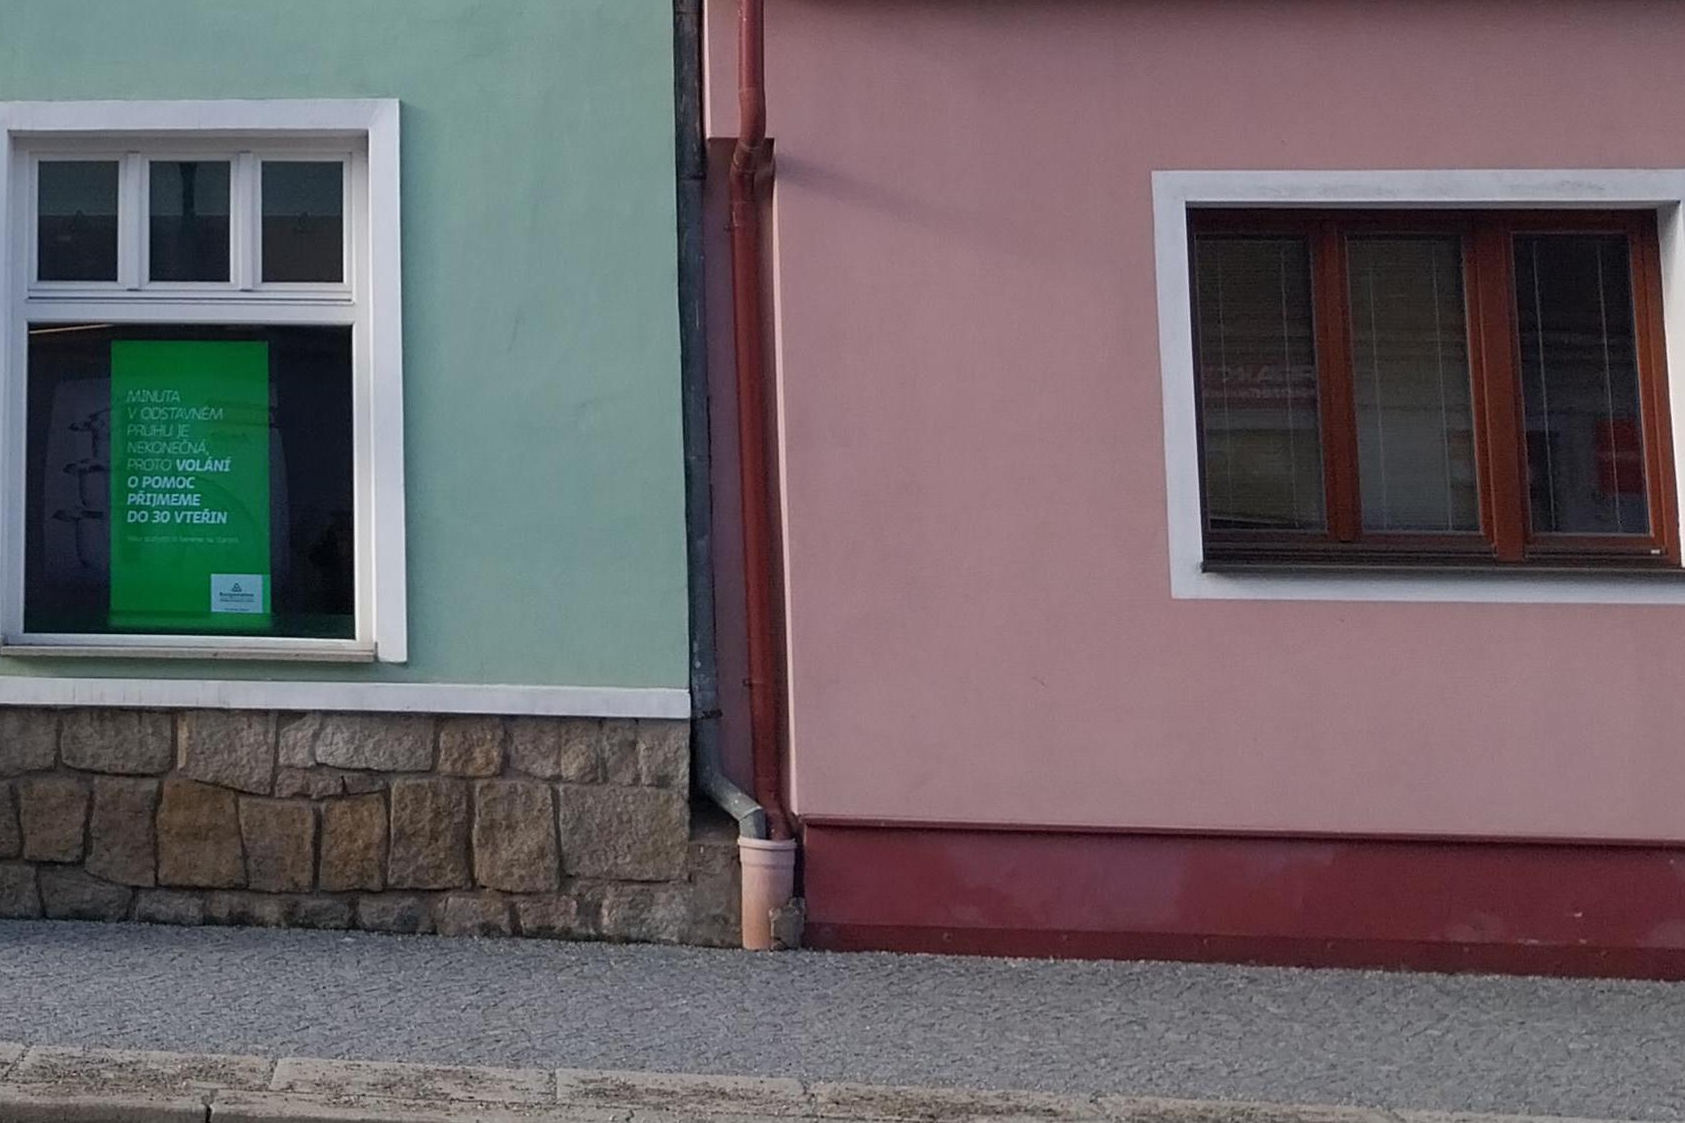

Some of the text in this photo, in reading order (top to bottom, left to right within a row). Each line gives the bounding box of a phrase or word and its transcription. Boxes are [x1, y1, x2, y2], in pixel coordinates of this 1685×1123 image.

[126, 389, 181, 403] MINUTA
[127, 404, 224, 421] V ODSTAVNÉM
[126, 423, 191, 439] PRUHU JE
[126, 438, 210, 456] NEKONEČNÁ,
[126, 455, 233, 472] PROTO VOLÁNÍ
[127, 475, 196, 489] O POMOC
[126, 489, 202, 507] PŘIJMEME
[126, 507, 228, 525] DO 30 VTEŘIN
